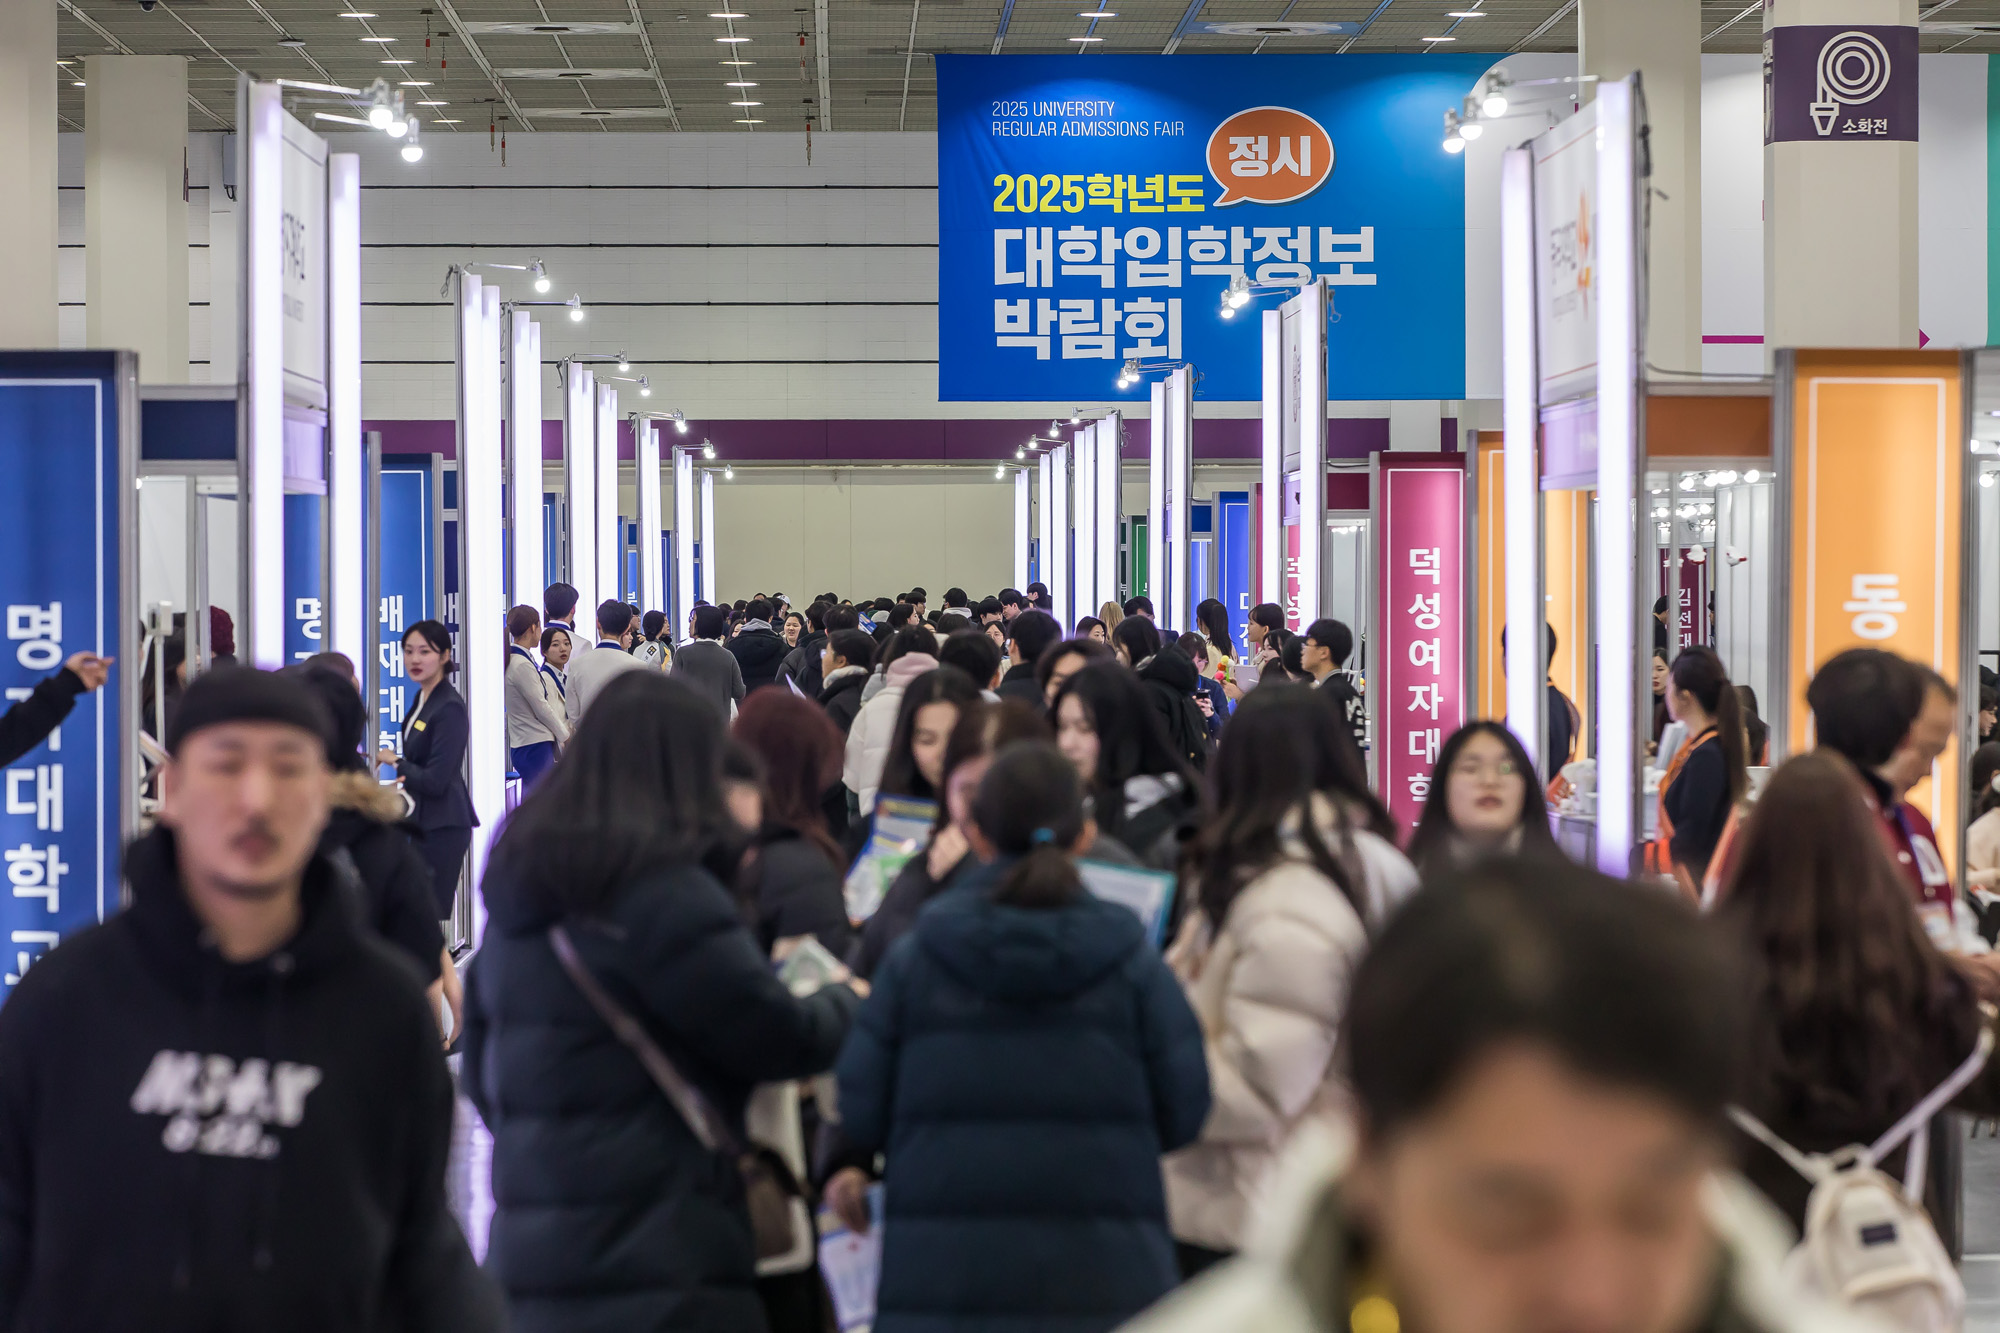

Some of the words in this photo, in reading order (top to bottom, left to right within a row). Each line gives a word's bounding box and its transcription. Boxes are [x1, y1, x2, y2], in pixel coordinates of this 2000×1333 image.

[992, 101, 1028, 117] 2025
[1033, 101, 1115, 117] UNIVERSITY
[992, 121, 1057, 137] REGULAR
[1061, 121, 1149, 137] ADMISSIONS
[1154, 121, 1185, 137] FAIR
[1842, 118, 1888, 135] 소화전
[1228, 135, 1312, 177] 정시
[993, 173, 1205, 213] 2025학년도
[994, 225, 1377, 288] 대학입학정보
[994, 297, 1183, 360] 박람회
[1843, 573, 1908, 639] 동
